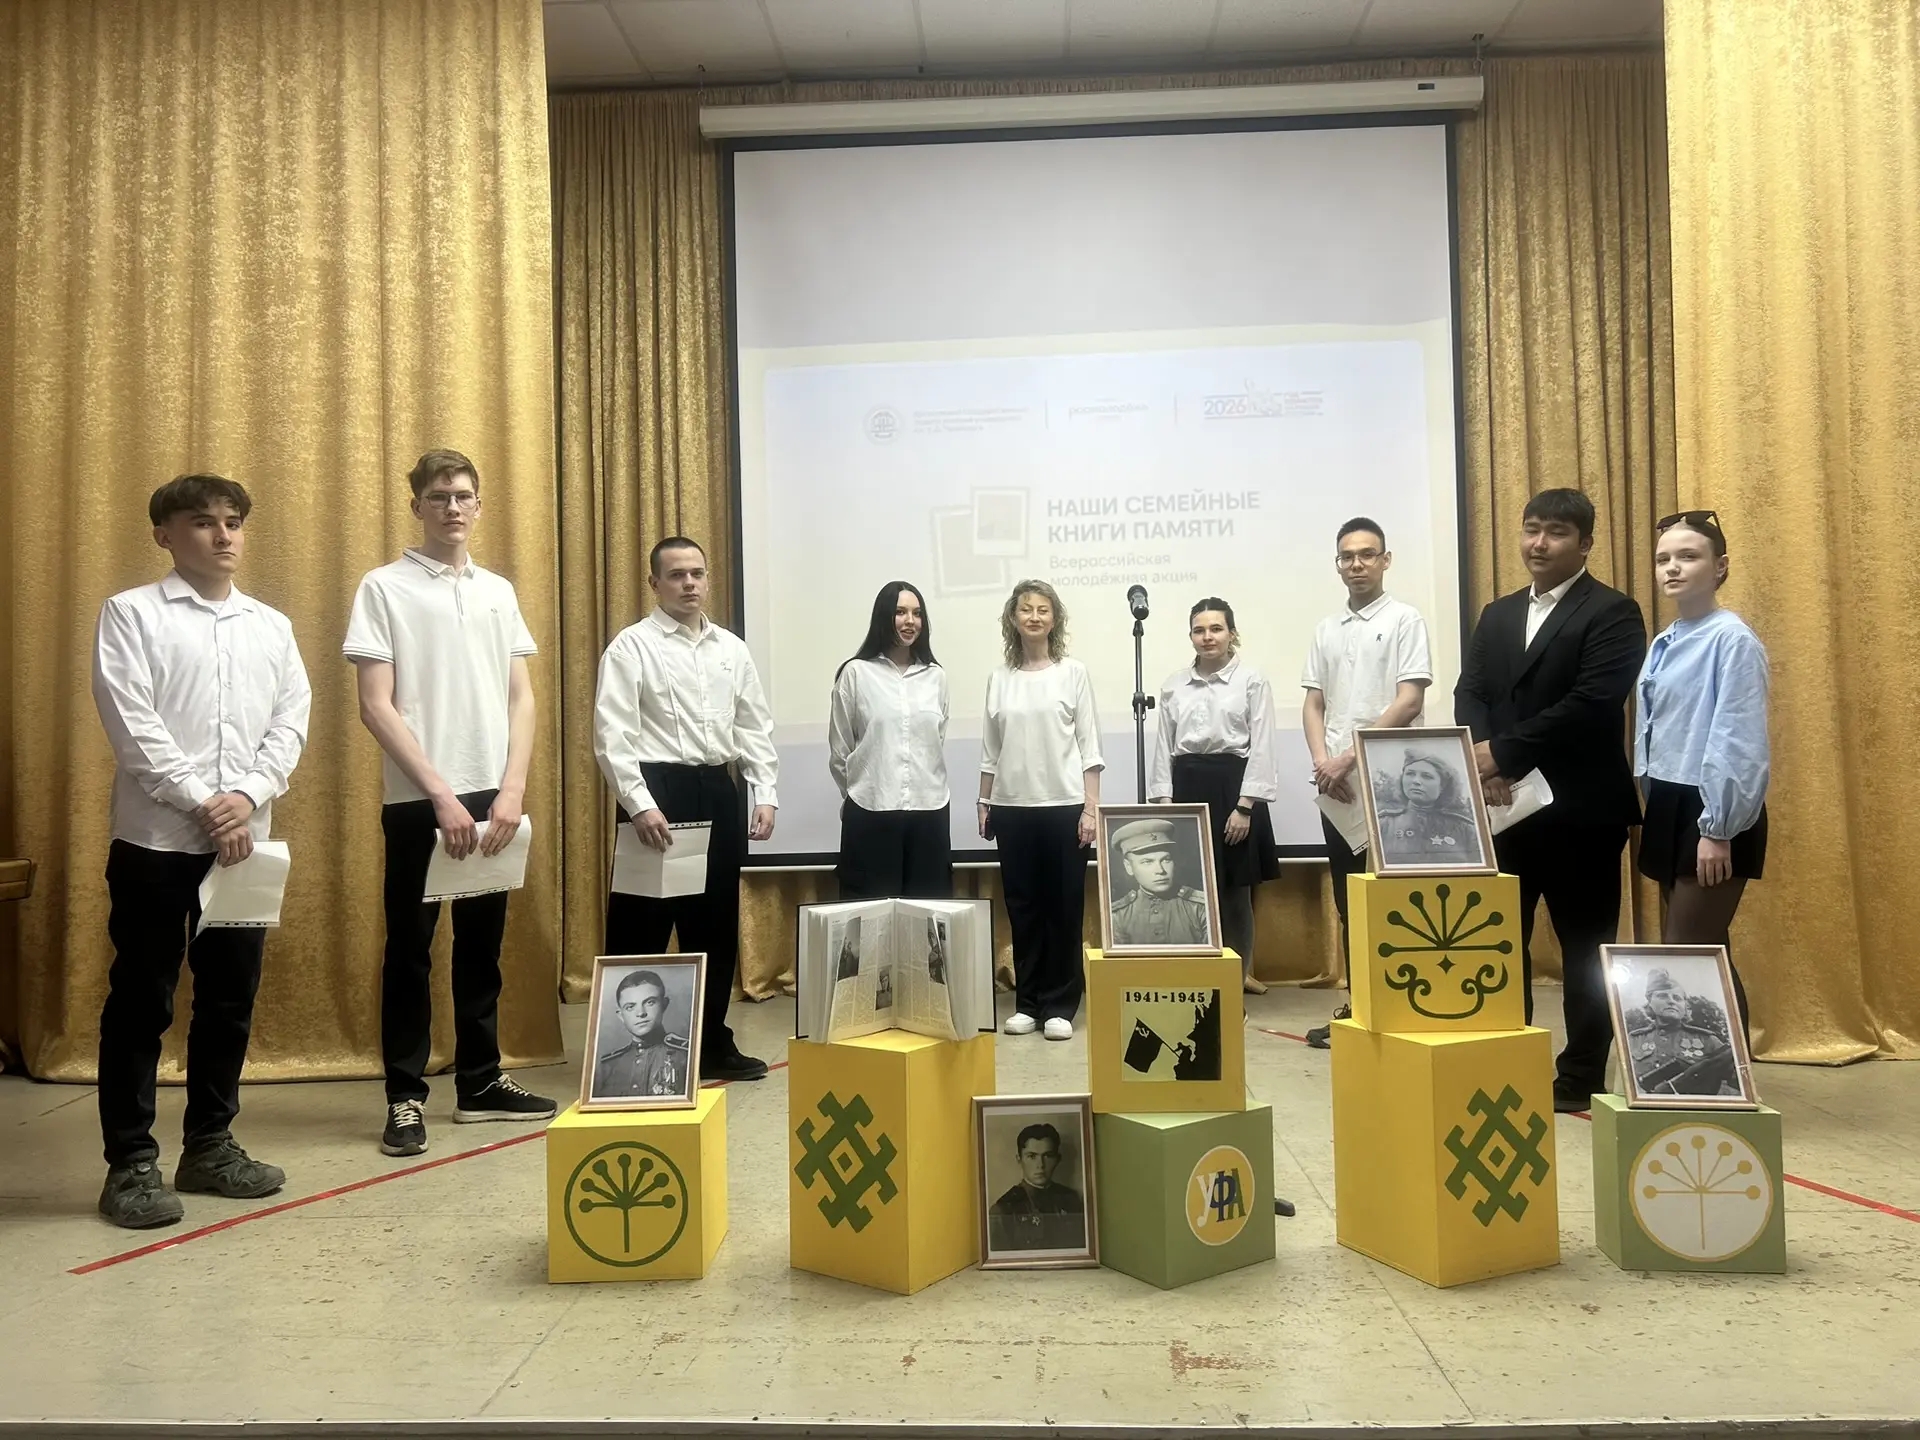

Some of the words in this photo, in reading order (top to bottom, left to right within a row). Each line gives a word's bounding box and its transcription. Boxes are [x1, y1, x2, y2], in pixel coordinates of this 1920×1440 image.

[1204, 399, 1247, 416] 2026
[1047, 497, 1118, 517] НАШИ
[1125, 488, 1260, 514] СЕМЕЙНЫЕ
[1048, 523, 1126, 543] КНИГИ
[1133, 518, 1234, 541] ПАМЯТИ
[1049, 553, 1172, 571] Всероссийская
[1152, 571, 1198, 585] акция
[1125, 991, 1206, 1003] 1941-1945
